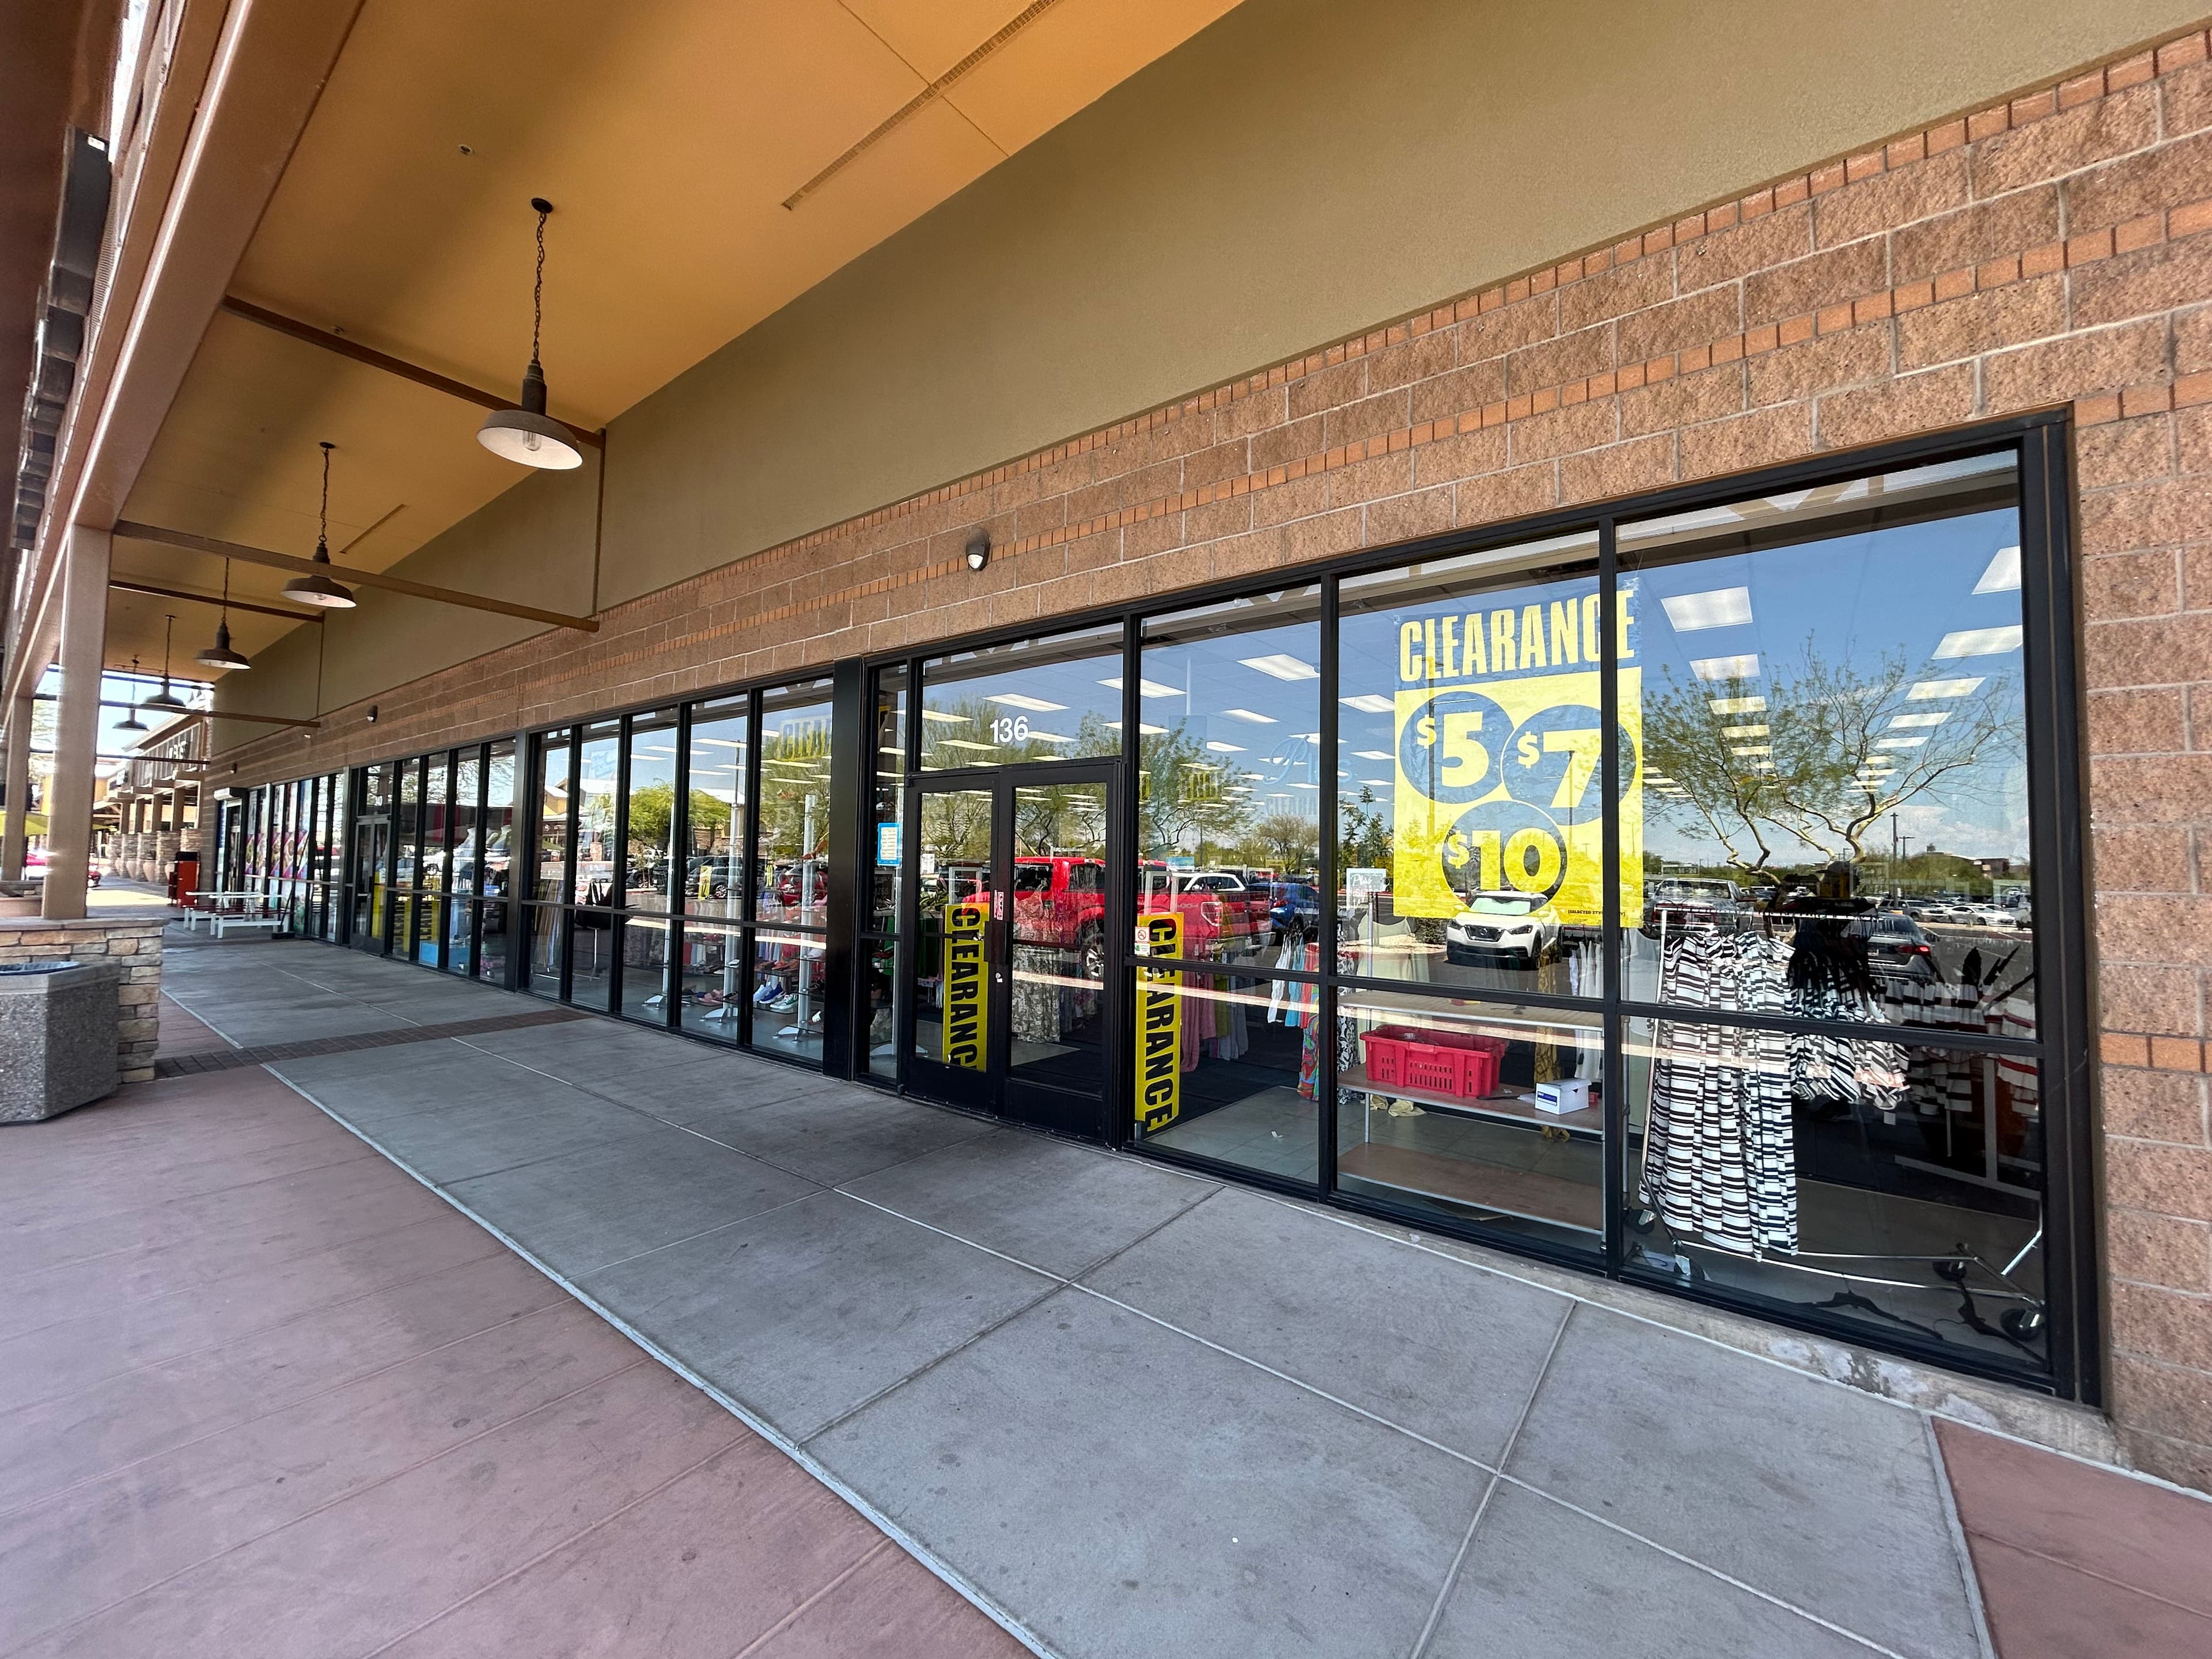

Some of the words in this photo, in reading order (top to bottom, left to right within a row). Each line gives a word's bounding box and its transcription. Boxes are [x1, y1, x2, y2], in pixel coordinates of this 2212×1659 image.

[1400, 590, 1635, 681] CLEARANCE
[989, 715, 1028, 743] 136
[1416, 711, 1489, 787] $5
[1517, 728, 1602, 808] $7
[1448, 827, 1561, 893] $10
[950, 907, 980, 1070] CLEARANC
